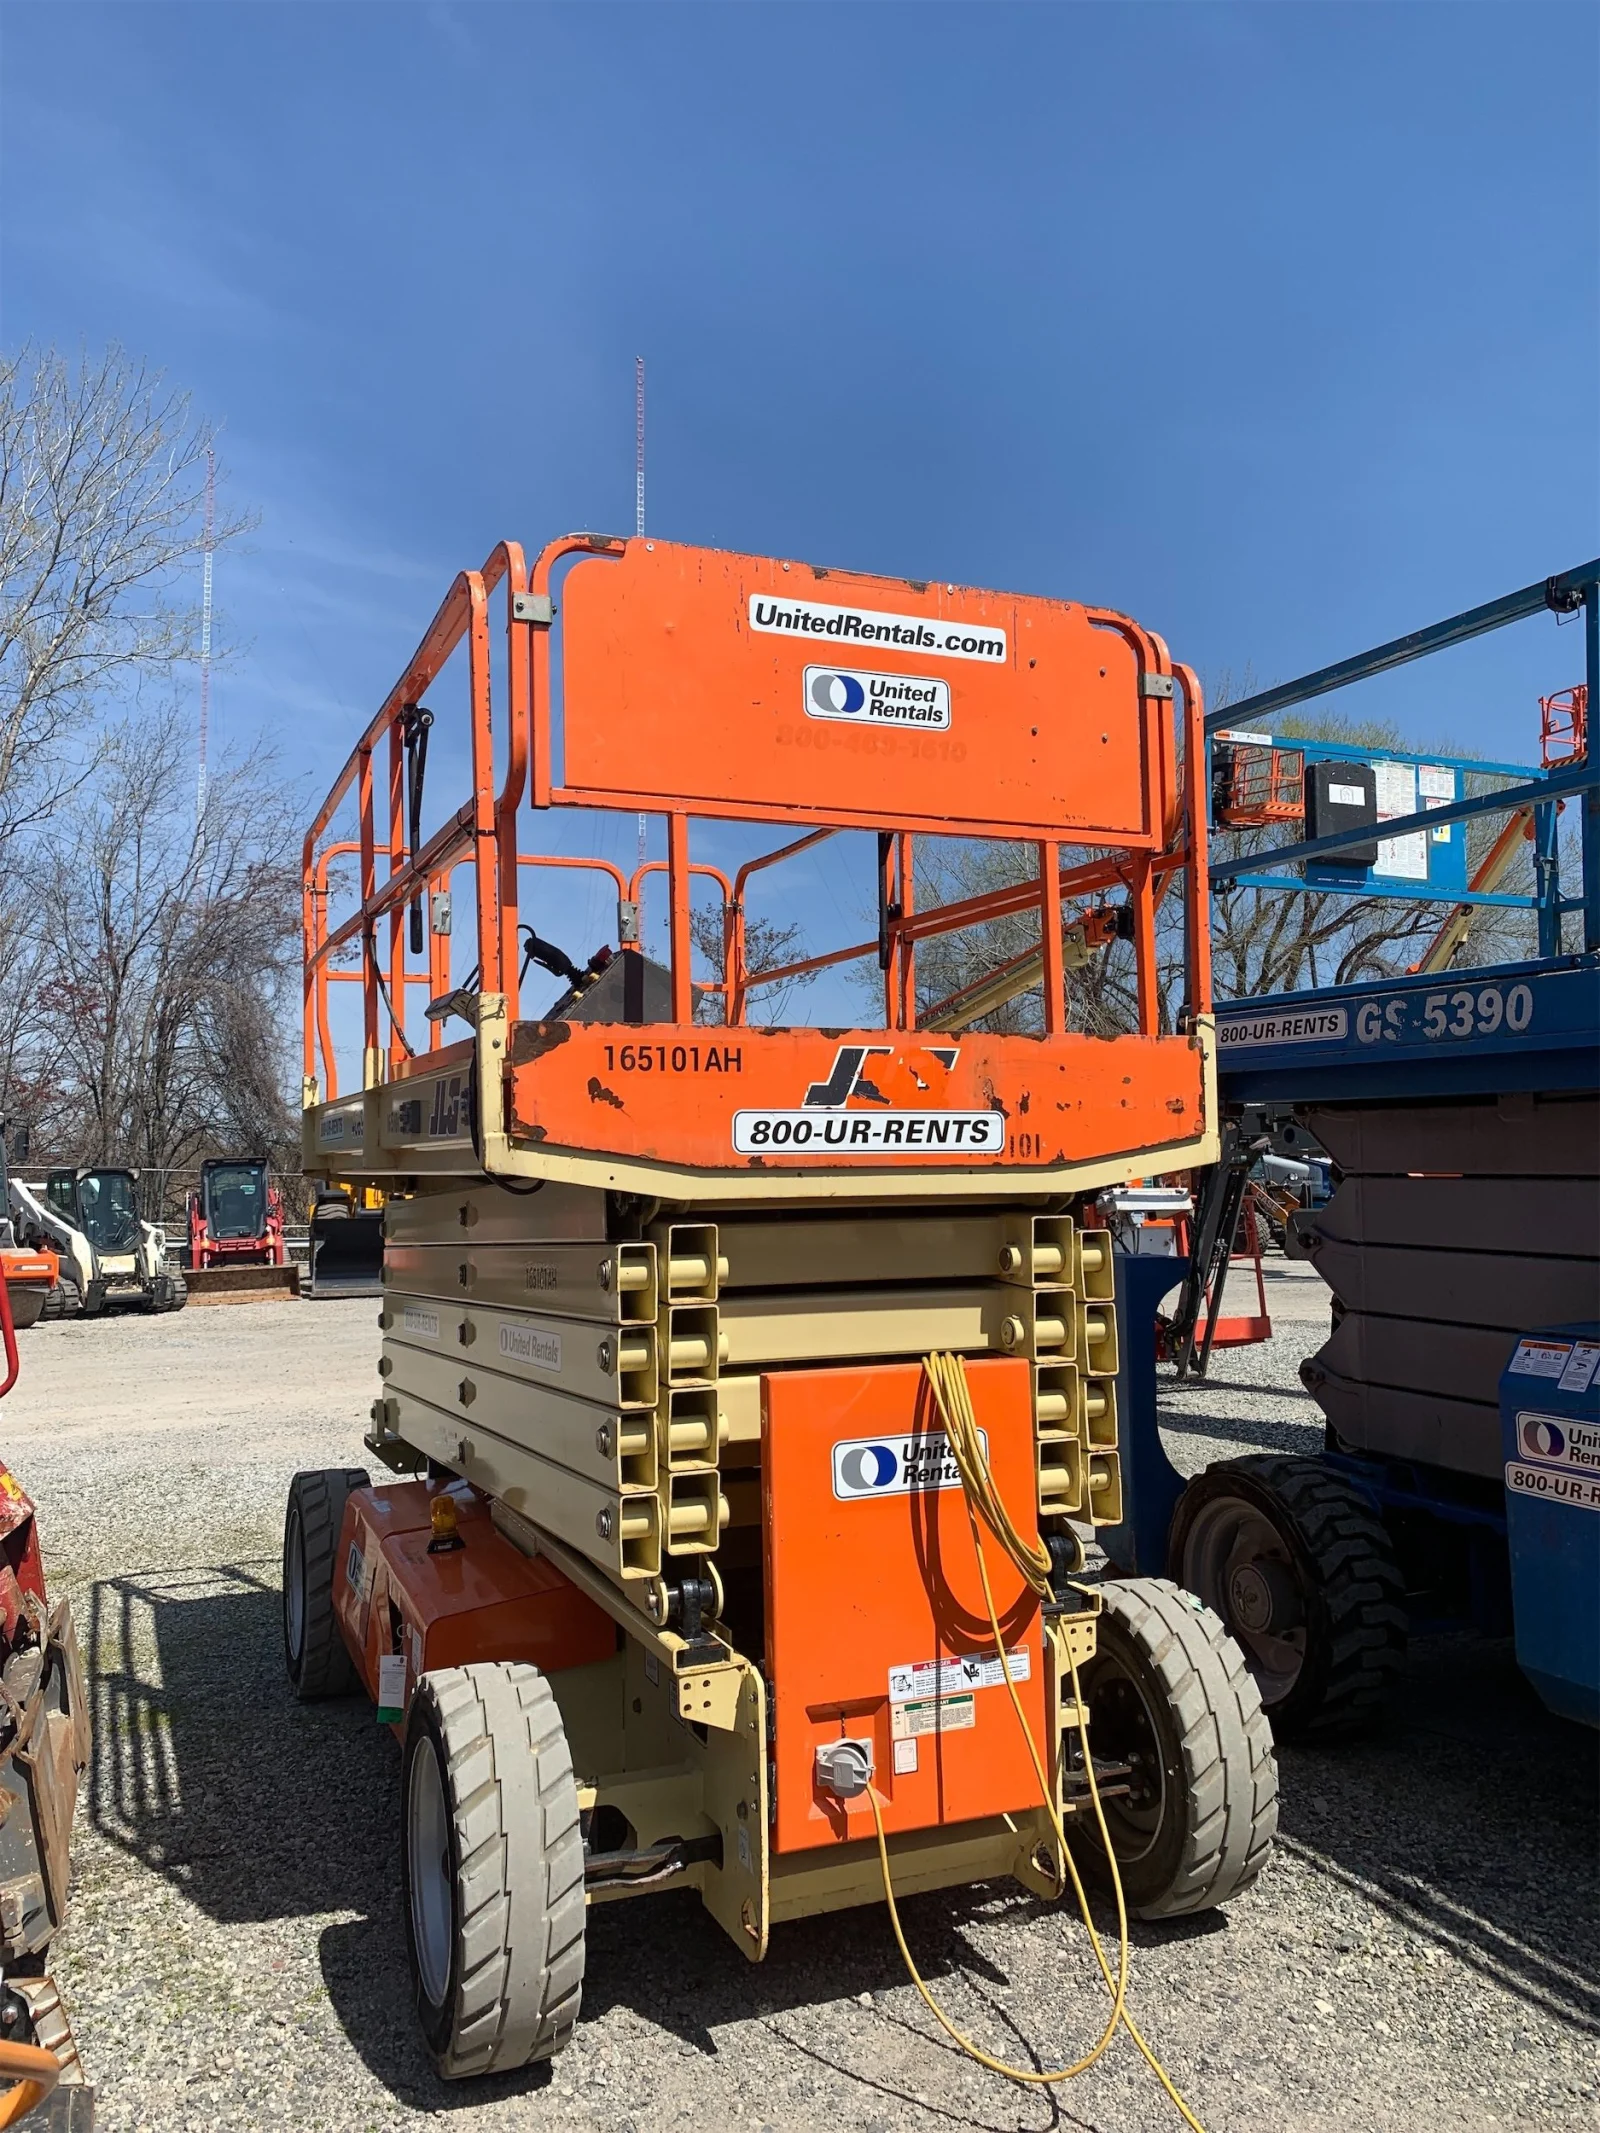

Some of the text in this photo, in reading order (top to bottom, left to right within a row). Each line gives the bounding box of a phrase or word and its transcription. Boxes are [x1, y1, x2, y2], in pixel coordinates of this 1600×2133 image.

[755, 602, 1004, 657] UnitedRentals.com
[869, 679, 937, 703] United
[869, 699, 944, 722] Rentals
[1220, 1014, 1339, 1043] 800-UR-RENTS
[604, 1045, 742, 1072] 165101AH
[750, 1119, 990, 1145] 800-UR-RENTS
[1256, 1191, 1279, 1212] CASE
[509, 1330, 559, 1363] United Rentals
